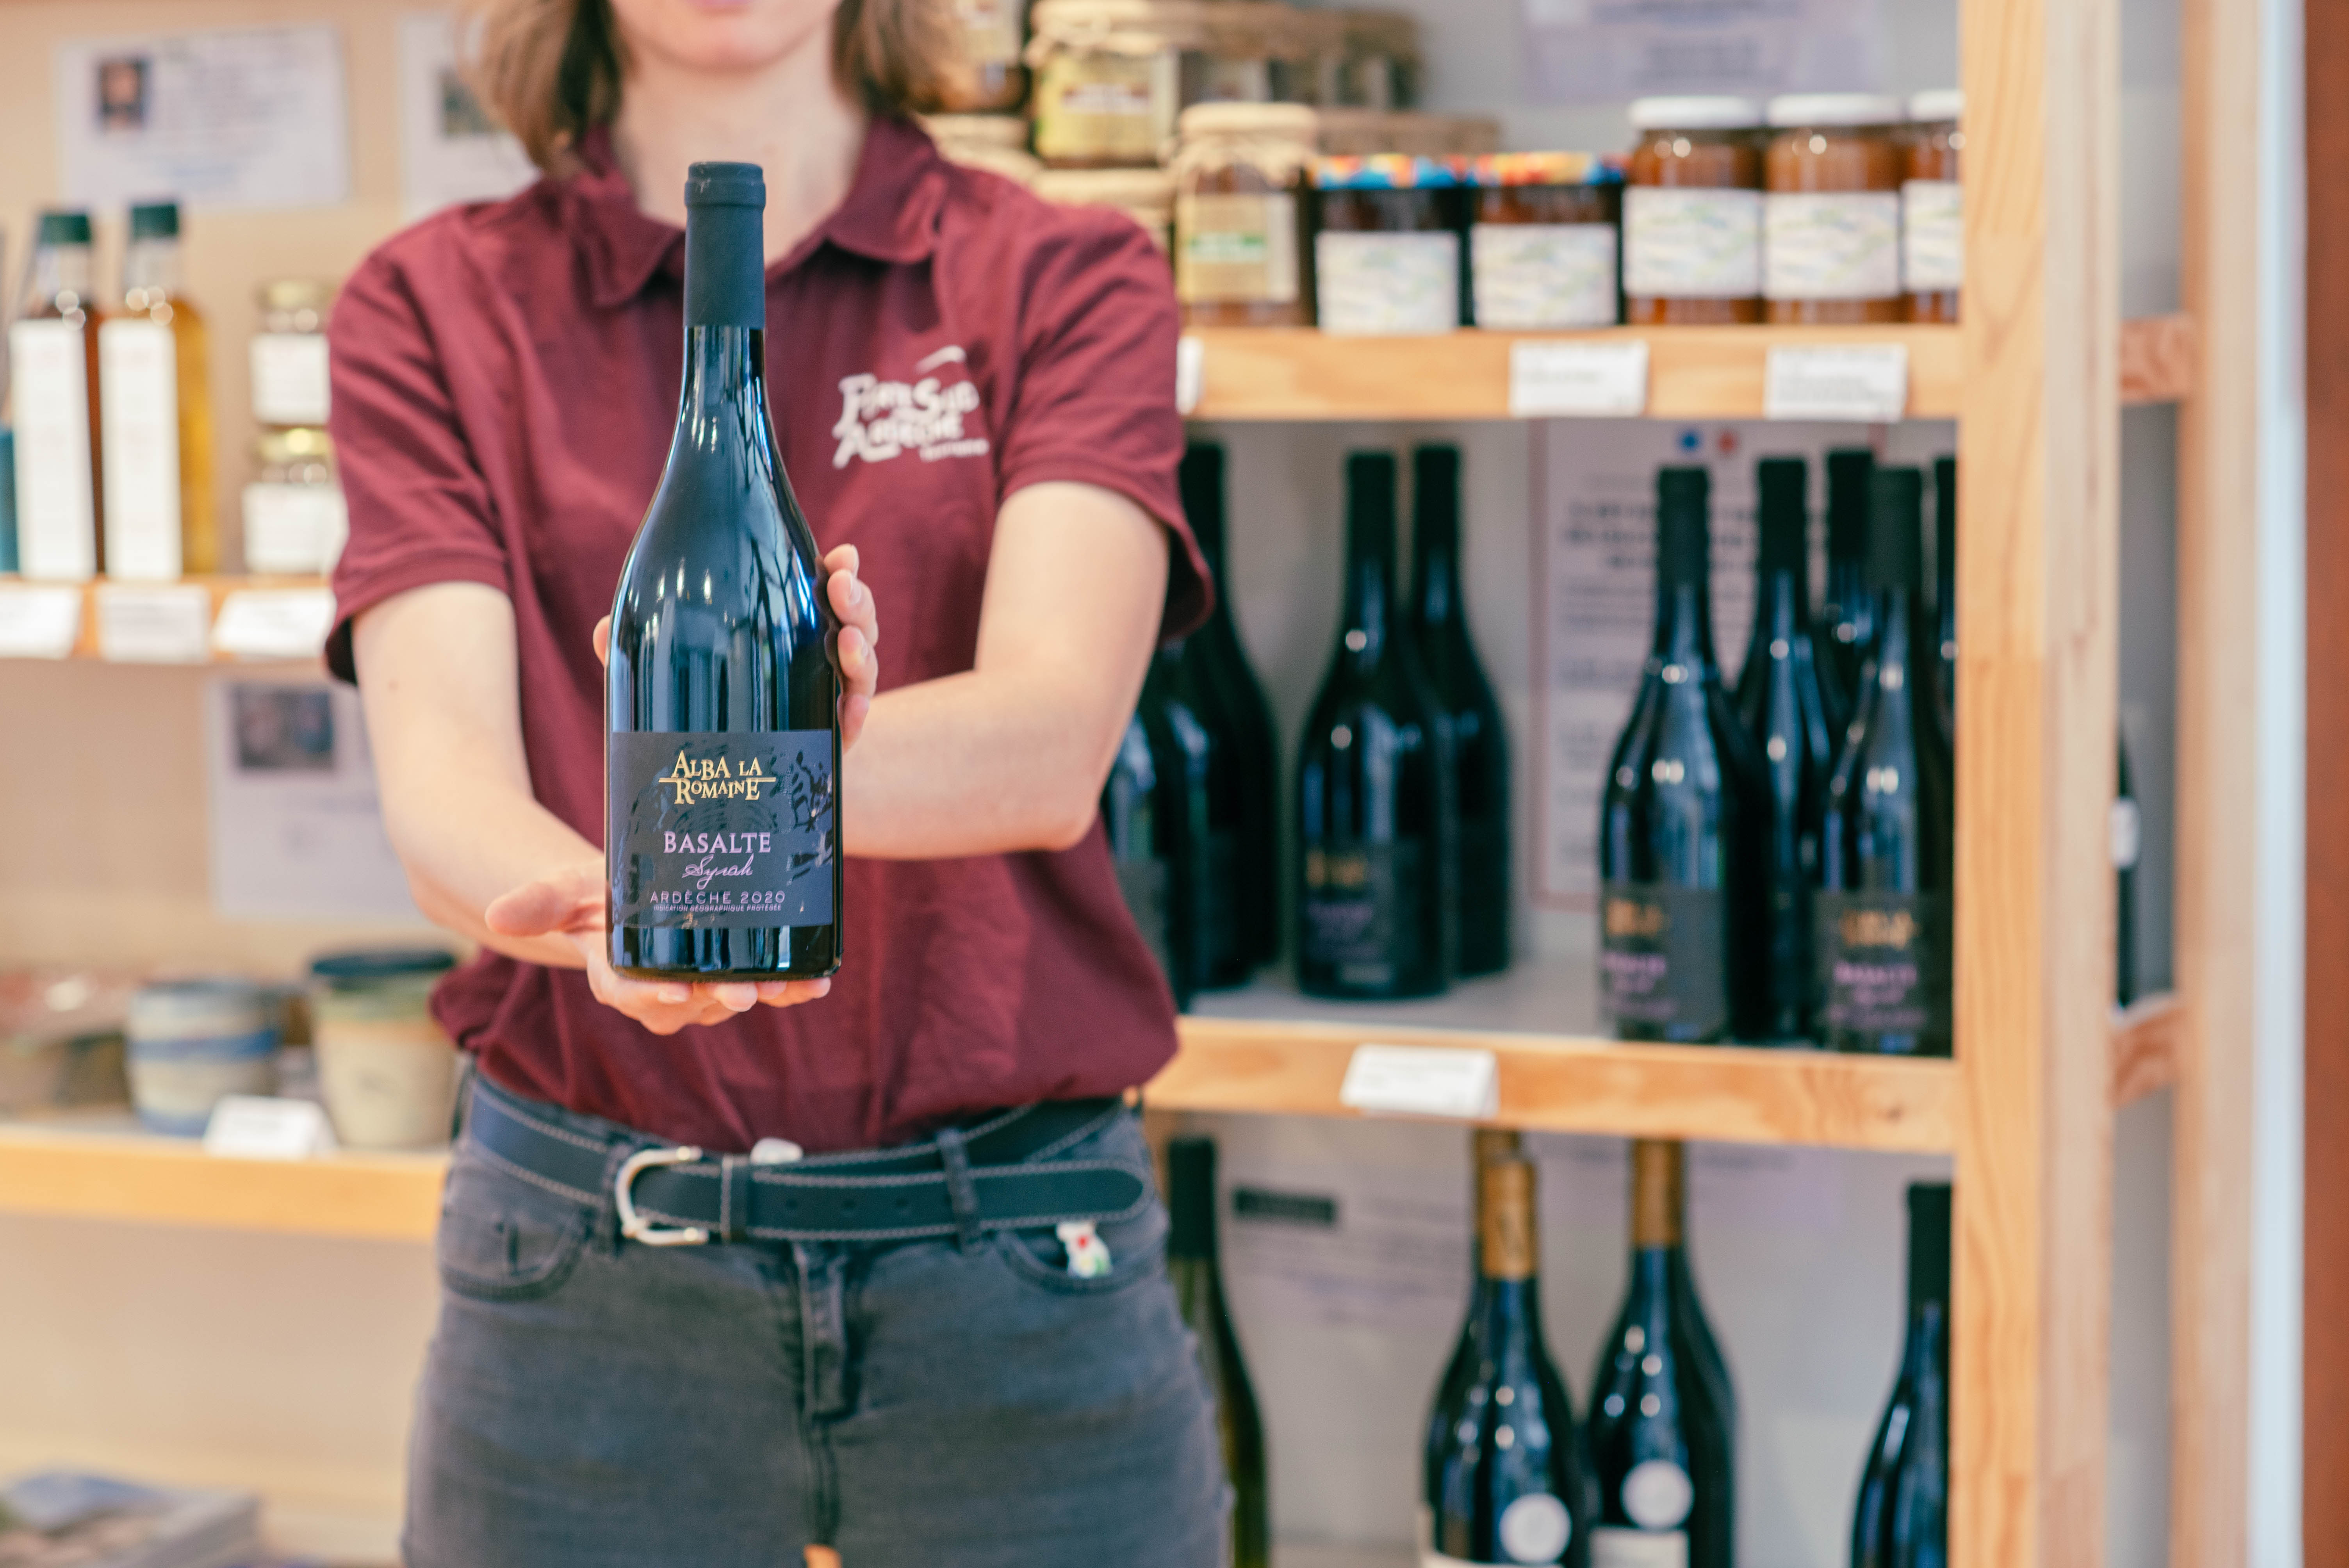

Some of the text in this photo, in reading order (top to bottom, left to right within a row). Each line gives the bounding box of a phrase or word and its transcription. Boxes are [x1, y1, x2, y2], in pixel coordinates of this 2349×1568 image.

[671, 750, 762, 780] ALBA LA
[674, 777, 759, 804] ROMAINE
[664, 831, 771, 853] BASALTE
[682, 853, 754, 890] Syrah
[650, 889, 785, 904] ARDÈCHE 2020
